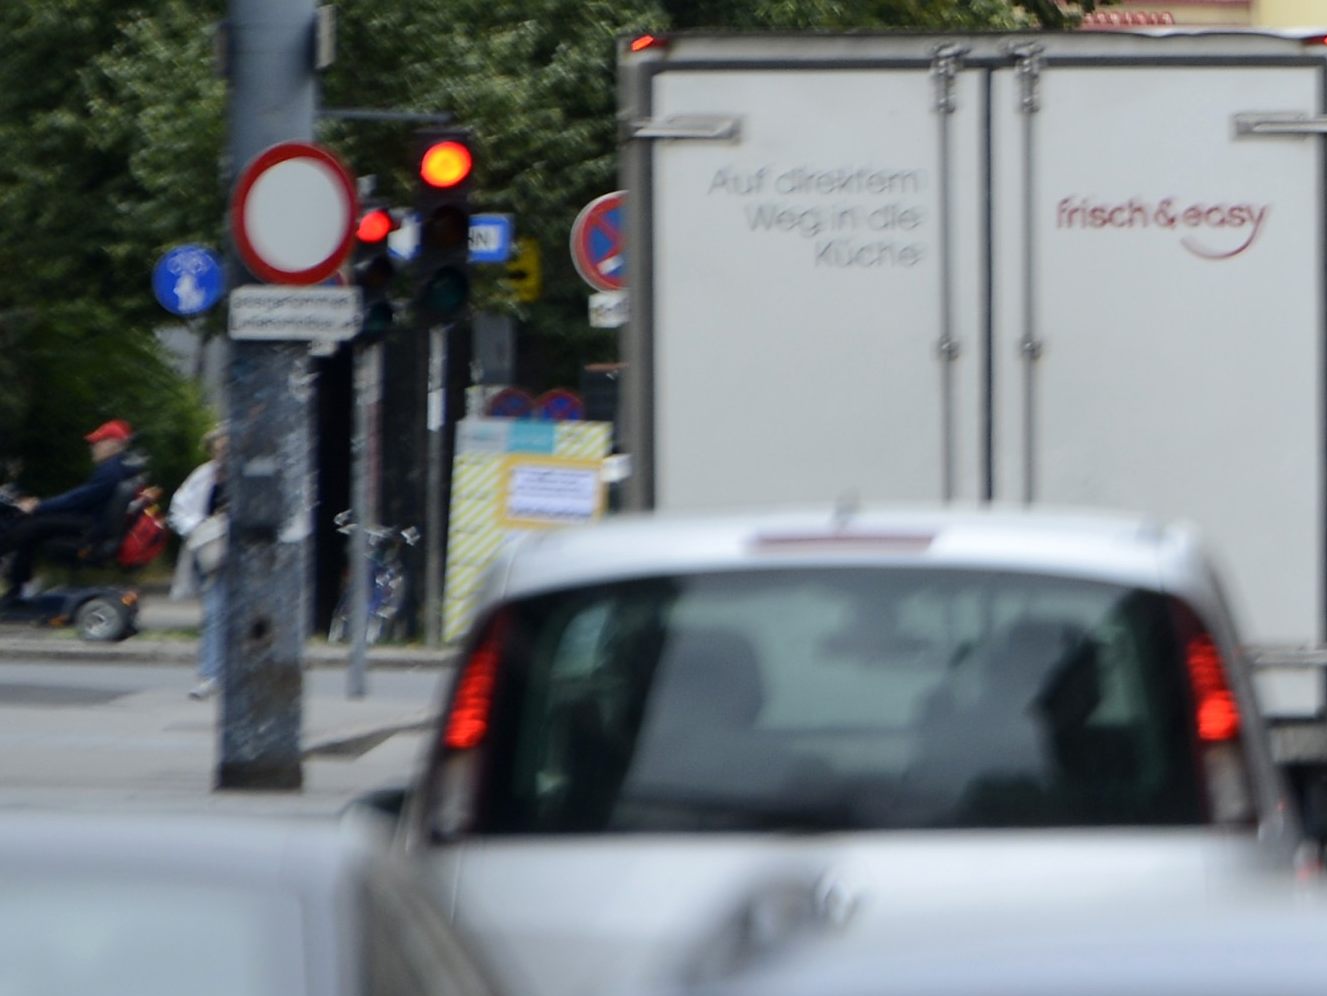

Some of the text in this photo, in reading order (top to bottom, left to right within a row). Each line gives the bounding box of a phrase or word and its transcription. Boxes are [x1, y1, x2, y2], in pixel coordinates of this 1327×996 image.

[708, 166, 767, 194] Auf
[746, 202, 921, 237] Weg in die
[814, 239, 921, 267] Küche
